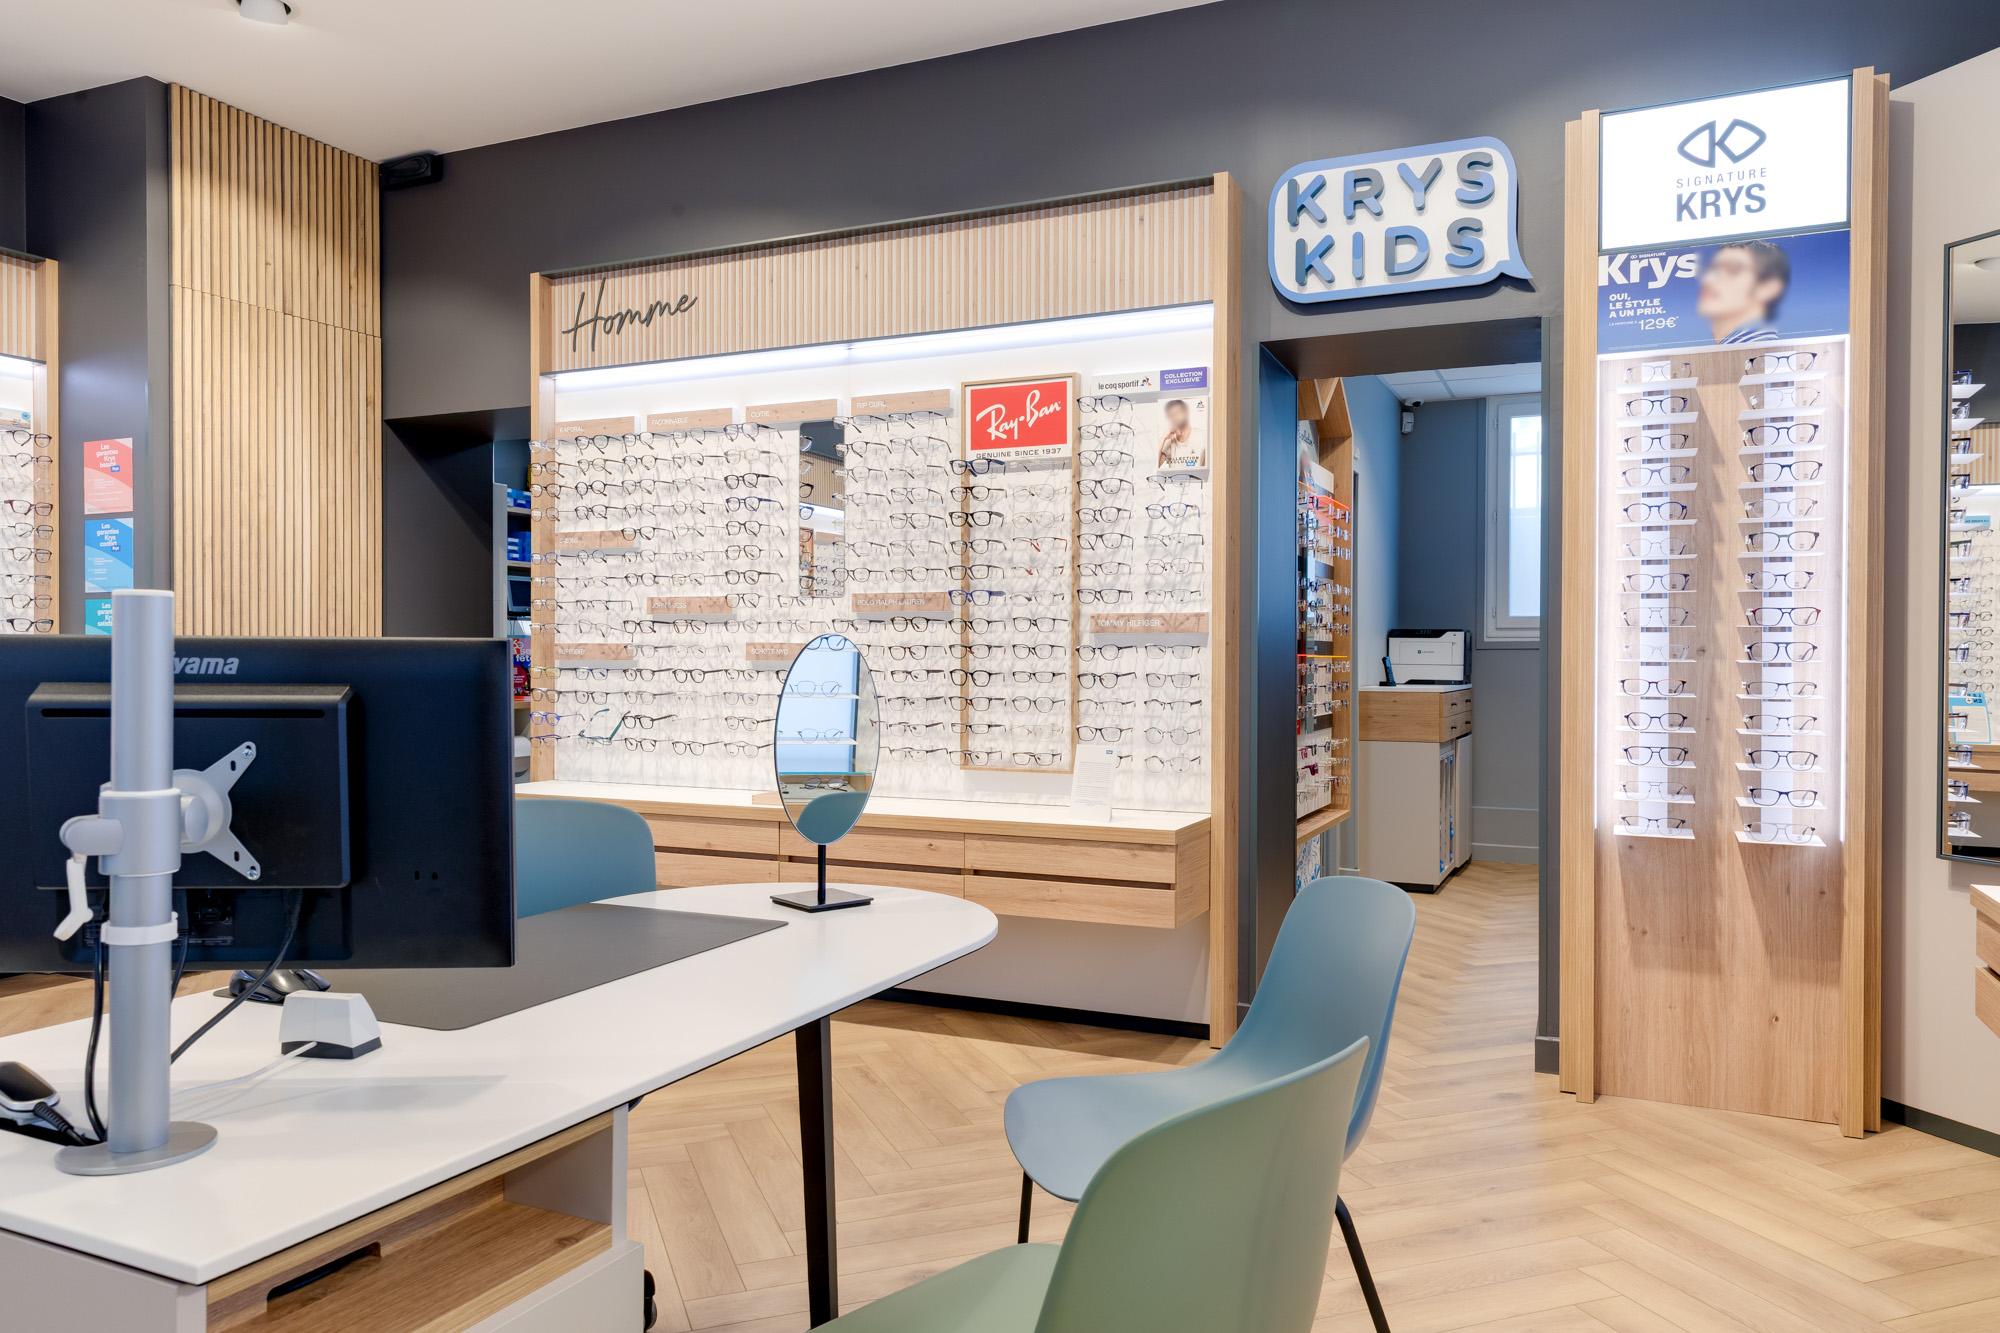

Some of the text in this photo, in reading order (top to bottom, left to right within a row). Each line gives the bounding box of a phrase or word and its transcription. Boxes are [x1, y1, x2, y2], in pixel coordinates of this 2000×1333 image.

[1676, 168, 1767, 189] SIGNATURE
[1287, 151, 1496, 227] KRYS
[1676, 183, 1767, 222] KRYS
[1294, 217, 1486, 287] KIDS
[1598, 253, 1698, 289] Krys
[1609, 293, 1631, 301] OUI,
[1609, 298, 1661, 310] LE STYLE
[562, 277, 698, 353] Homme
[1619, 309, 1634, 317] UN
[1636, 307, 1667, 316] PRIX.
[1164, 371, 1203, 379] COLLECTION
[1098, 380, 1139, 390] le coq sportif
[976, 447, 1062, 459] GENUINE SINCE 1937
[173, 656, 240, 675] yama
